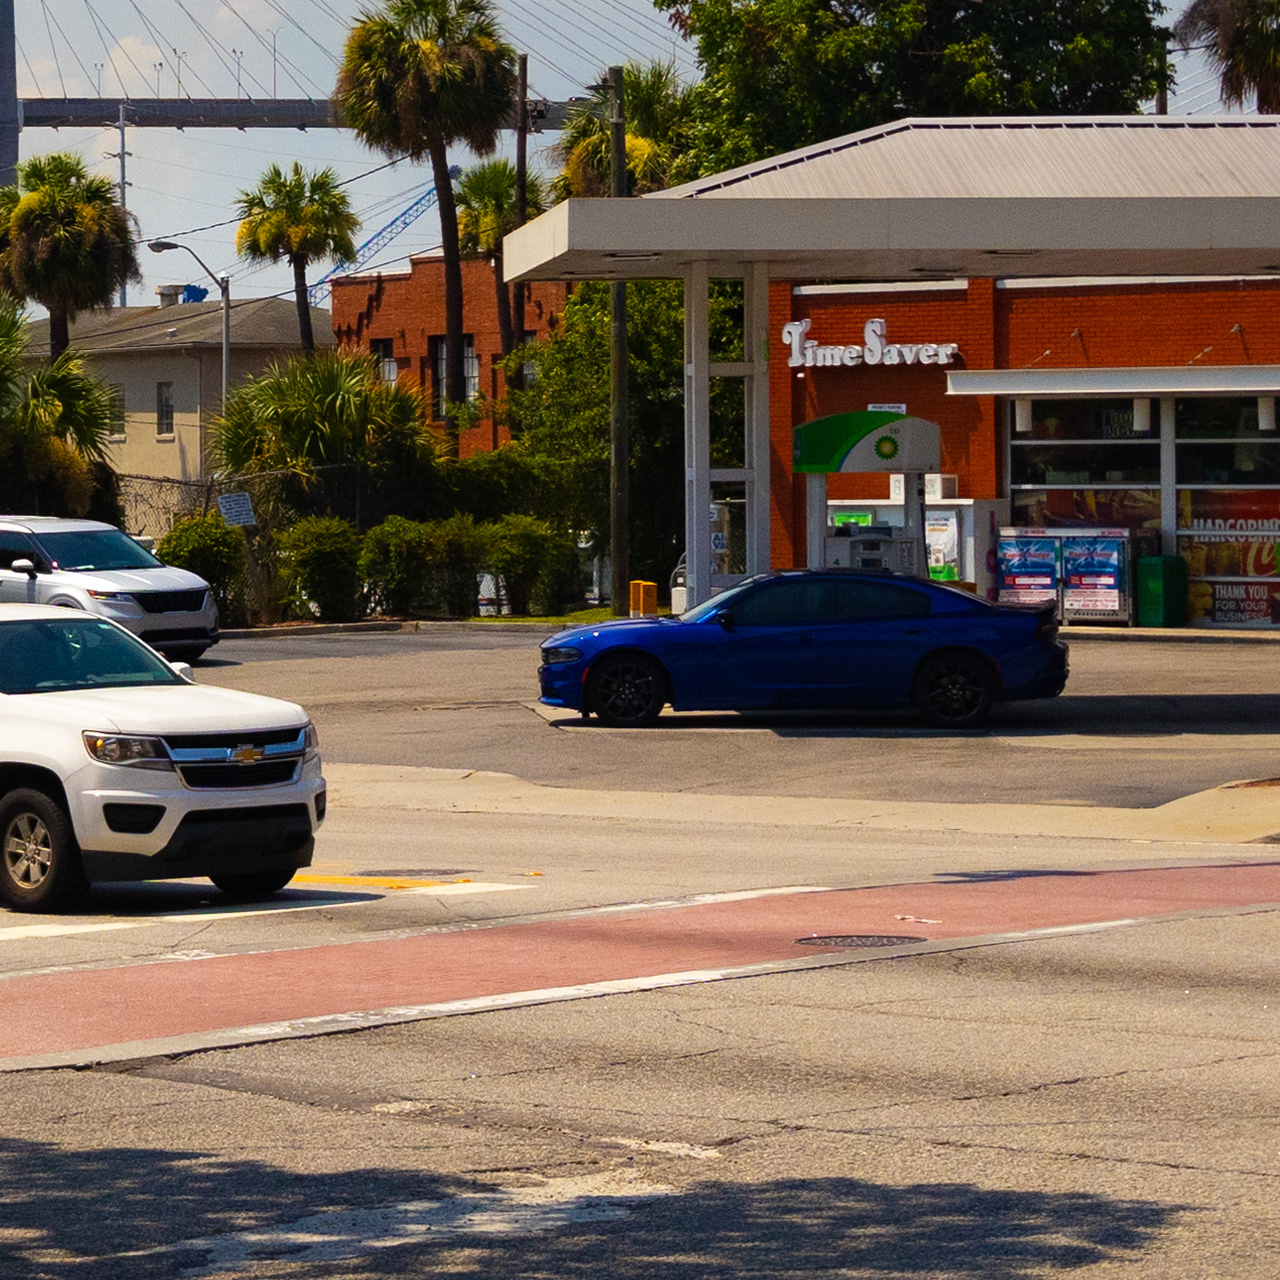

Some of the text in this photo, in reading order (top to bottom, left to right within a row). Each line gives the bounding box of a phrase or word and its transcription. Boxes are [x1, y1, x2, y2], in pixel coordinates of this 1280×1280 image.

[1214, 585, 1267, 598] THANK YOU
[1215, 600, 1267, 611] FOR YOUR
[1216, 611, 1264, 622] BUSINESS
